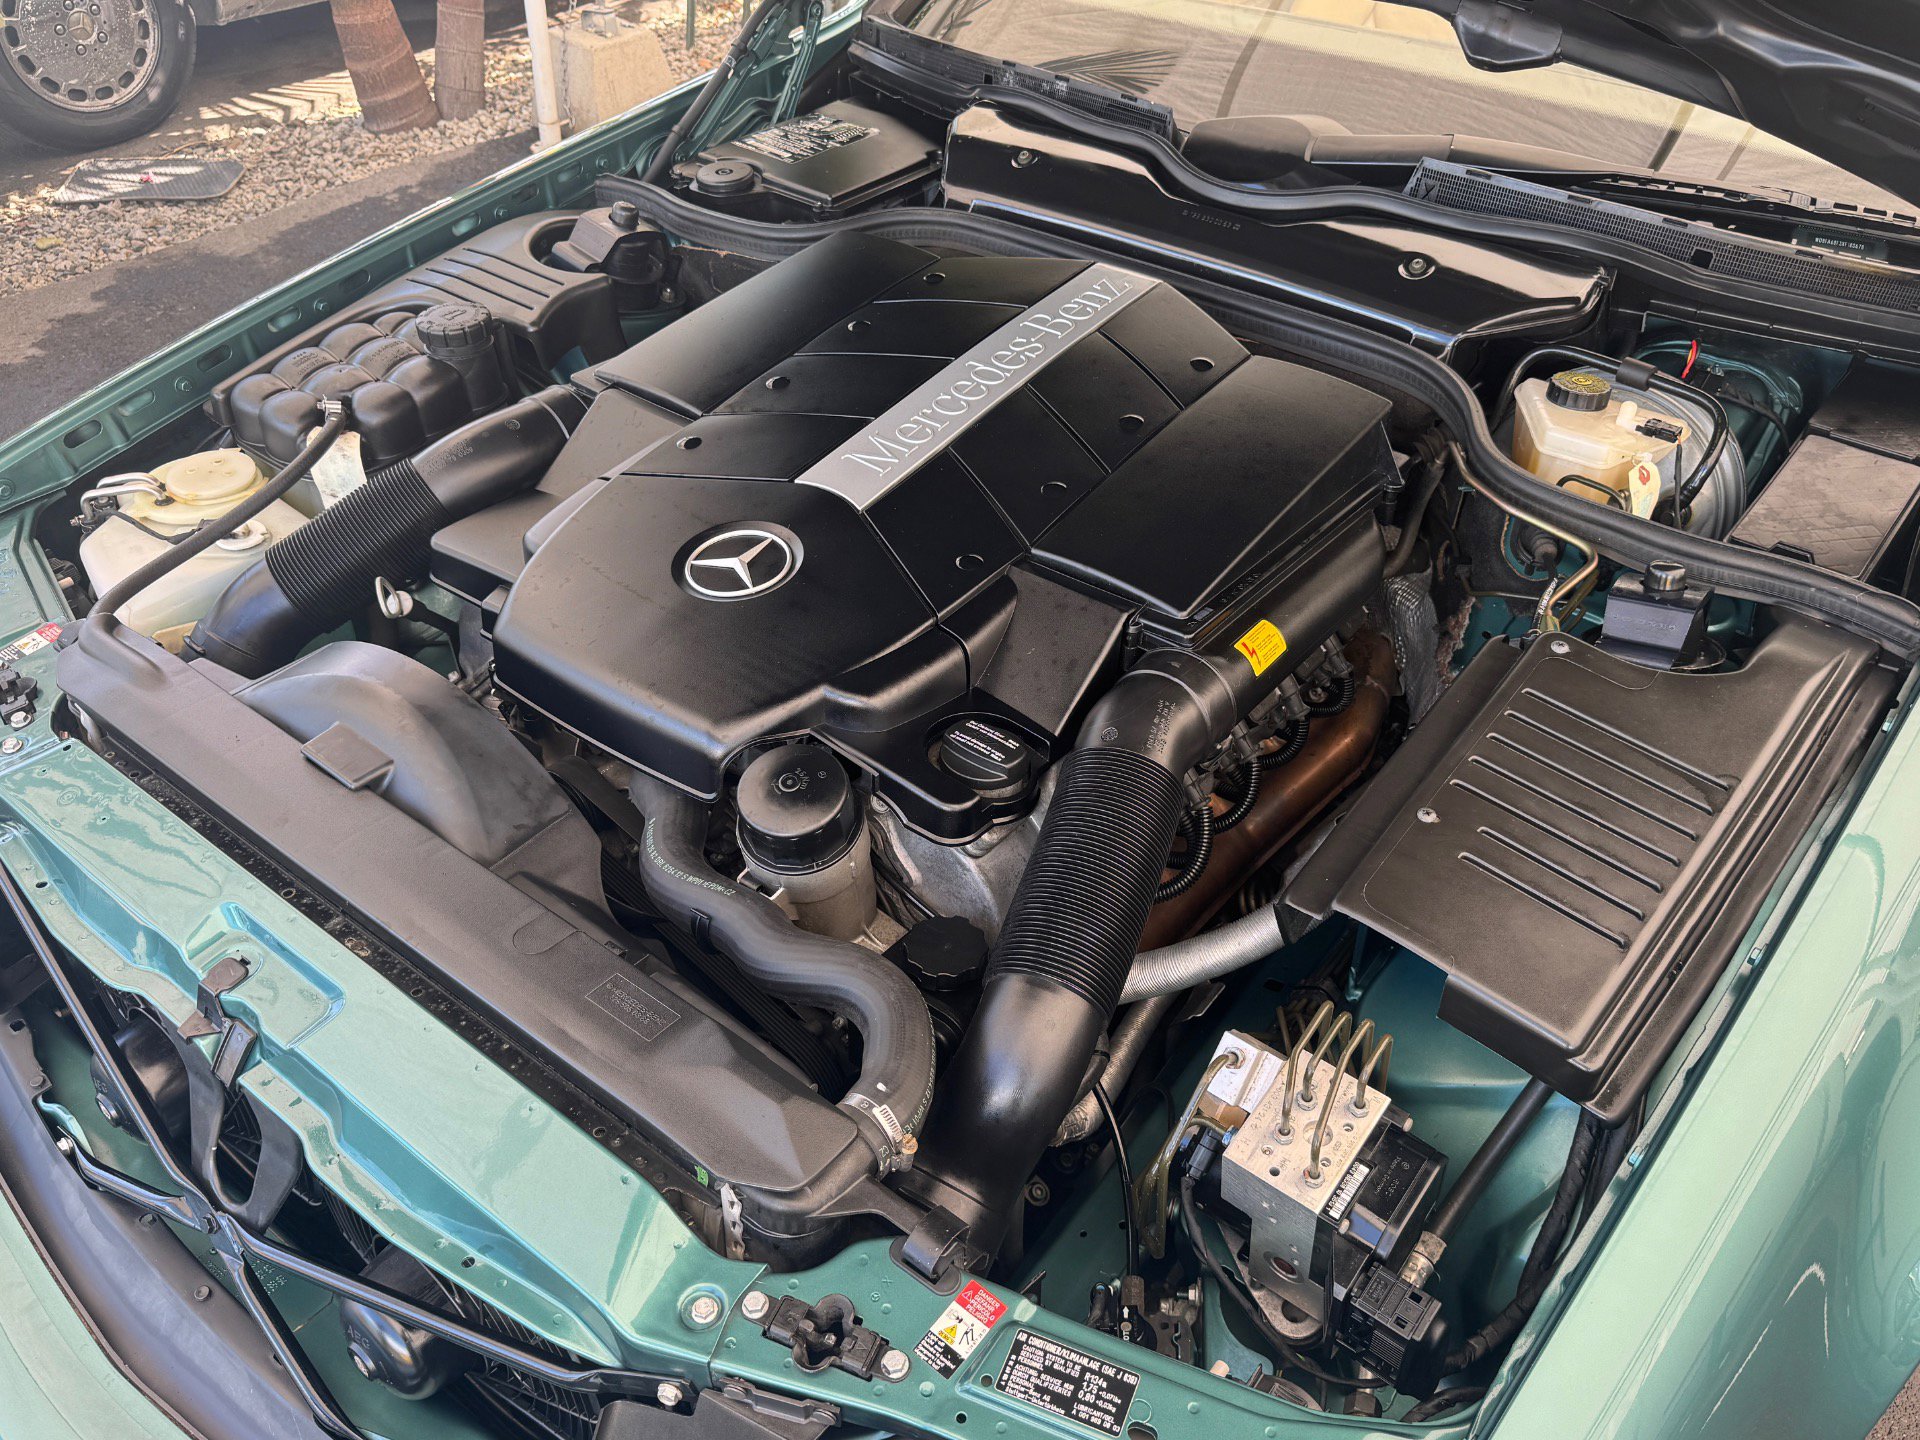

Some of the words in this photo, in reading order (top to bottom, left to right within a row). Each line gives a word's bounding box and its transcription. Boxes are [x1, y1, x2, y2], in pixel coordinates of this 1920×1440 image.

[841, 278, 1133, 477] Mercedes-Benz
[723, 888, 736, 896] CZ
[974, 1294, 995, 1313] GEFAHR
[978, 1289, 1000, 1309] DANGER
[966, 1304, 988, 1323] PELIGRO
[969, 1299, 995, 1321] PERICOLO
[348, 1325, 370, 1350] AEG
[1017, 1332, 1028, 1342] AIR
[1028, 1336, 1101, 1371] CONDITIONER/KLIMAANLAGE
[1101, 1365, 1117, 1377] (SAE
[1116, 1370, 1123, 1379] J
[1017, 1355, 1045, 1370] PERSONNEL
[1020, 1349, 1044, 1363] SERVICED
[1053, 1363, 1080, 1378] QUALIFIED
[1045, 1353, 1065, 1365] SYSTEM
[1010, 1375, 1036, 1389] PERSONAL
[1012, 1368, 1030, 1380] DURCH
[1029, 1376, 1072, 1397] QUALIFIZIERTES
[1040, 1373, 1063, 1386] SERVICE
[1063, 1382, 1075, 1391] NUR
[1080, 1382, 1099, 1394] 1,75
[1084, 1373, 1108, 1388] R134a
[1042, 1394, 1051, 1402] AG
[1077, 1390, 1096, 1403] 0,80
[1074, 1403, 1116, 1424] LUBRICANT/OEL
